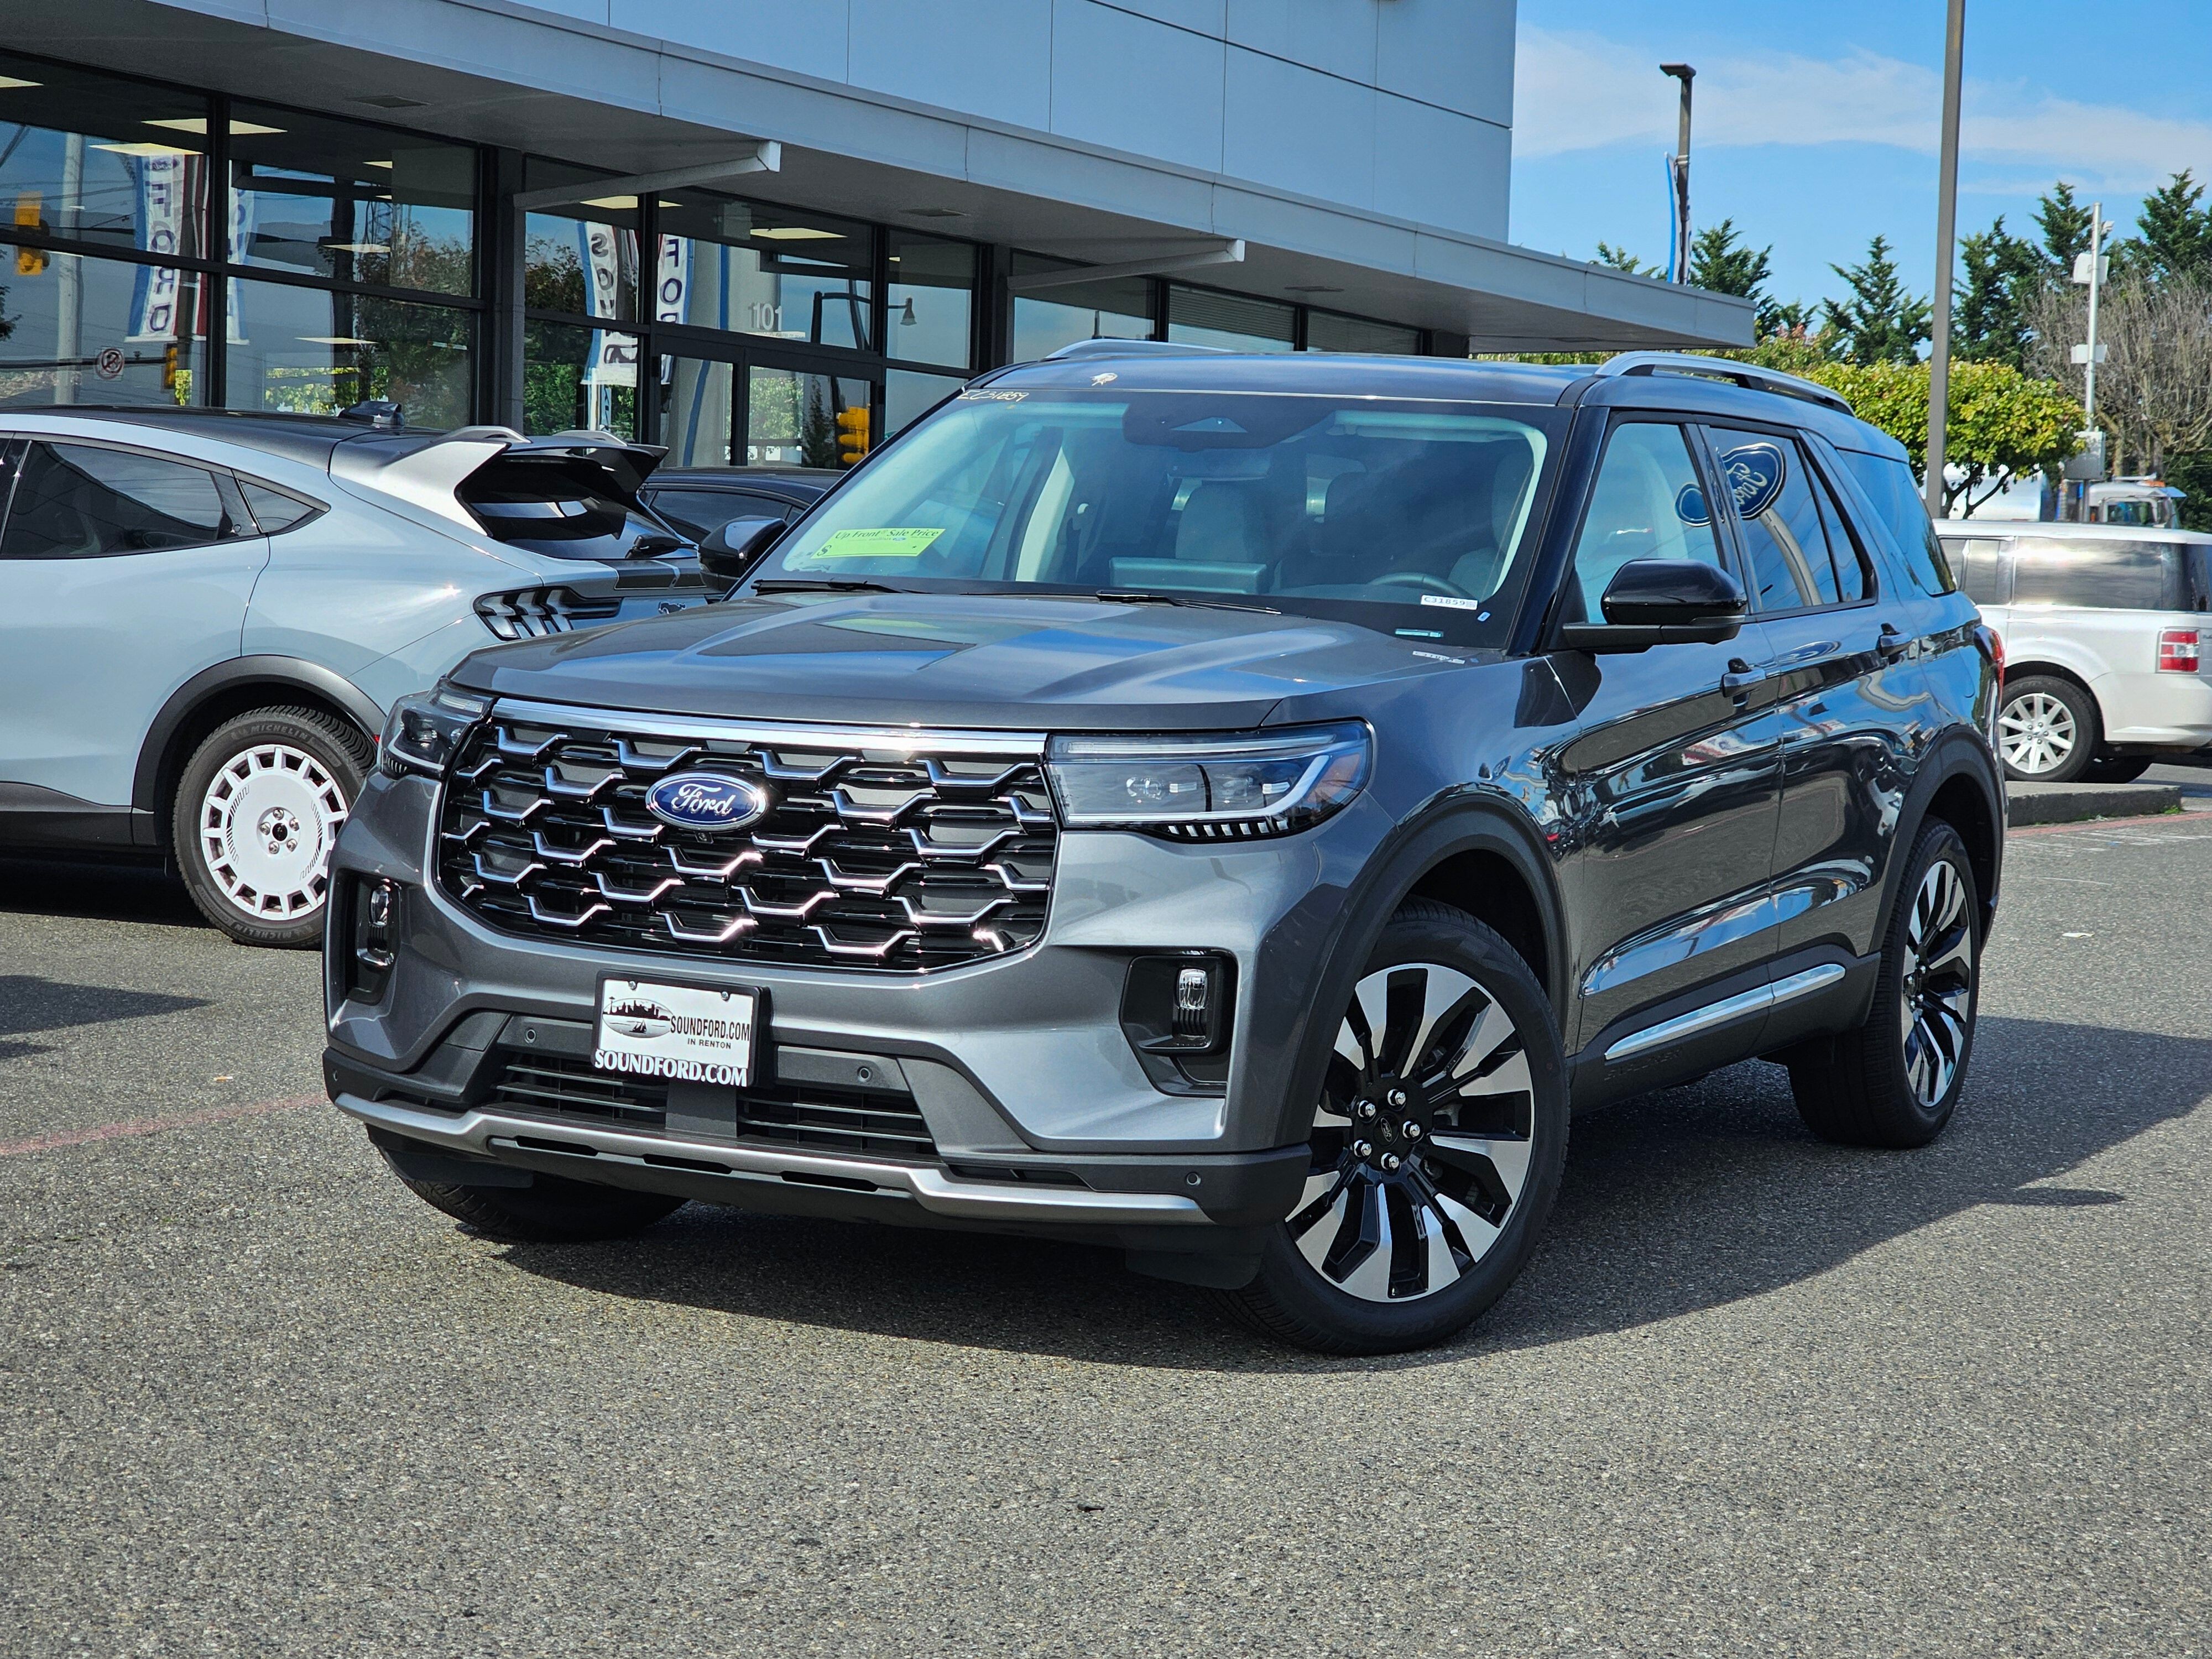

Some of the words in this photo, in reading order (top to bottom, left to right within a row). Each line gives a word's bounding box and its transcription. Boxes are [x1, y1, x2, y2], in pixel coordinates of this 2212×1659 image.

[753, 302, 782, 331] 101
[835, 531, 849, 540] Up
[1424, 597, 1465, 606] C31859
[251, 724, 309, 740] MICHELIN
[671, 783, 736, 817] Ford
[234, 923, 293, 940] MICHELIN
[670, 1015, 750, 1041] SOUNDFORD.COM
[699, 1040, 731, 1049] RENTON
[594, 1049, 747, 1087] SOUNDFORD.COM
